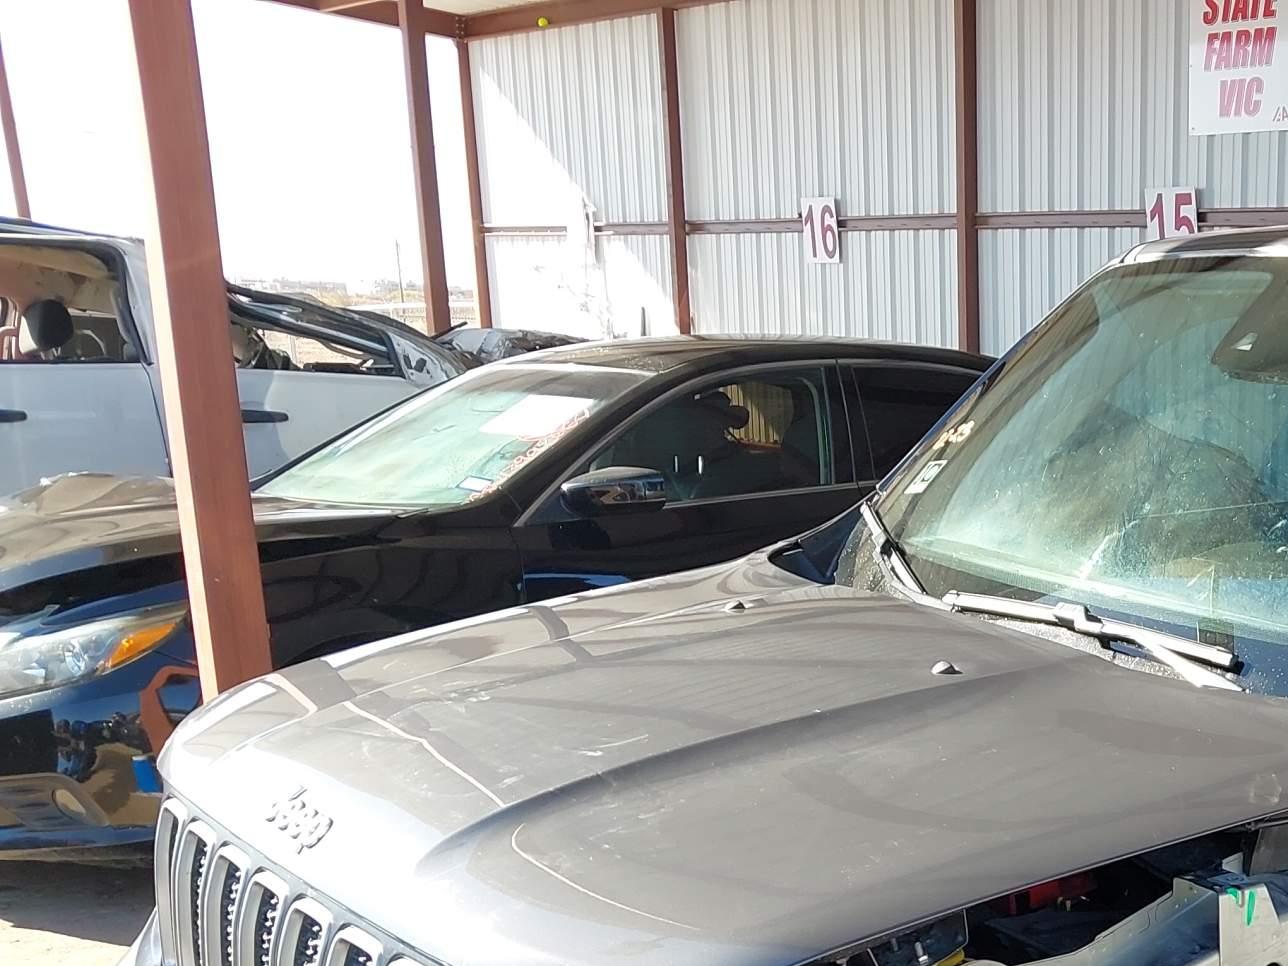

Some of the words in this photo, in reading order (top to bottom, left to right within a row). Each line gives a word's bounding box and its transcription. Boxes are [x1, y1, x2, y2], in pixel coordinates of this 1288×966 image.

[1204, 26, 1277, 72] FARM
[1219, 76, 1264, 118] VIC
[804, 204, 837, 259] 16
[1150, 192, 1195, 240] 15
